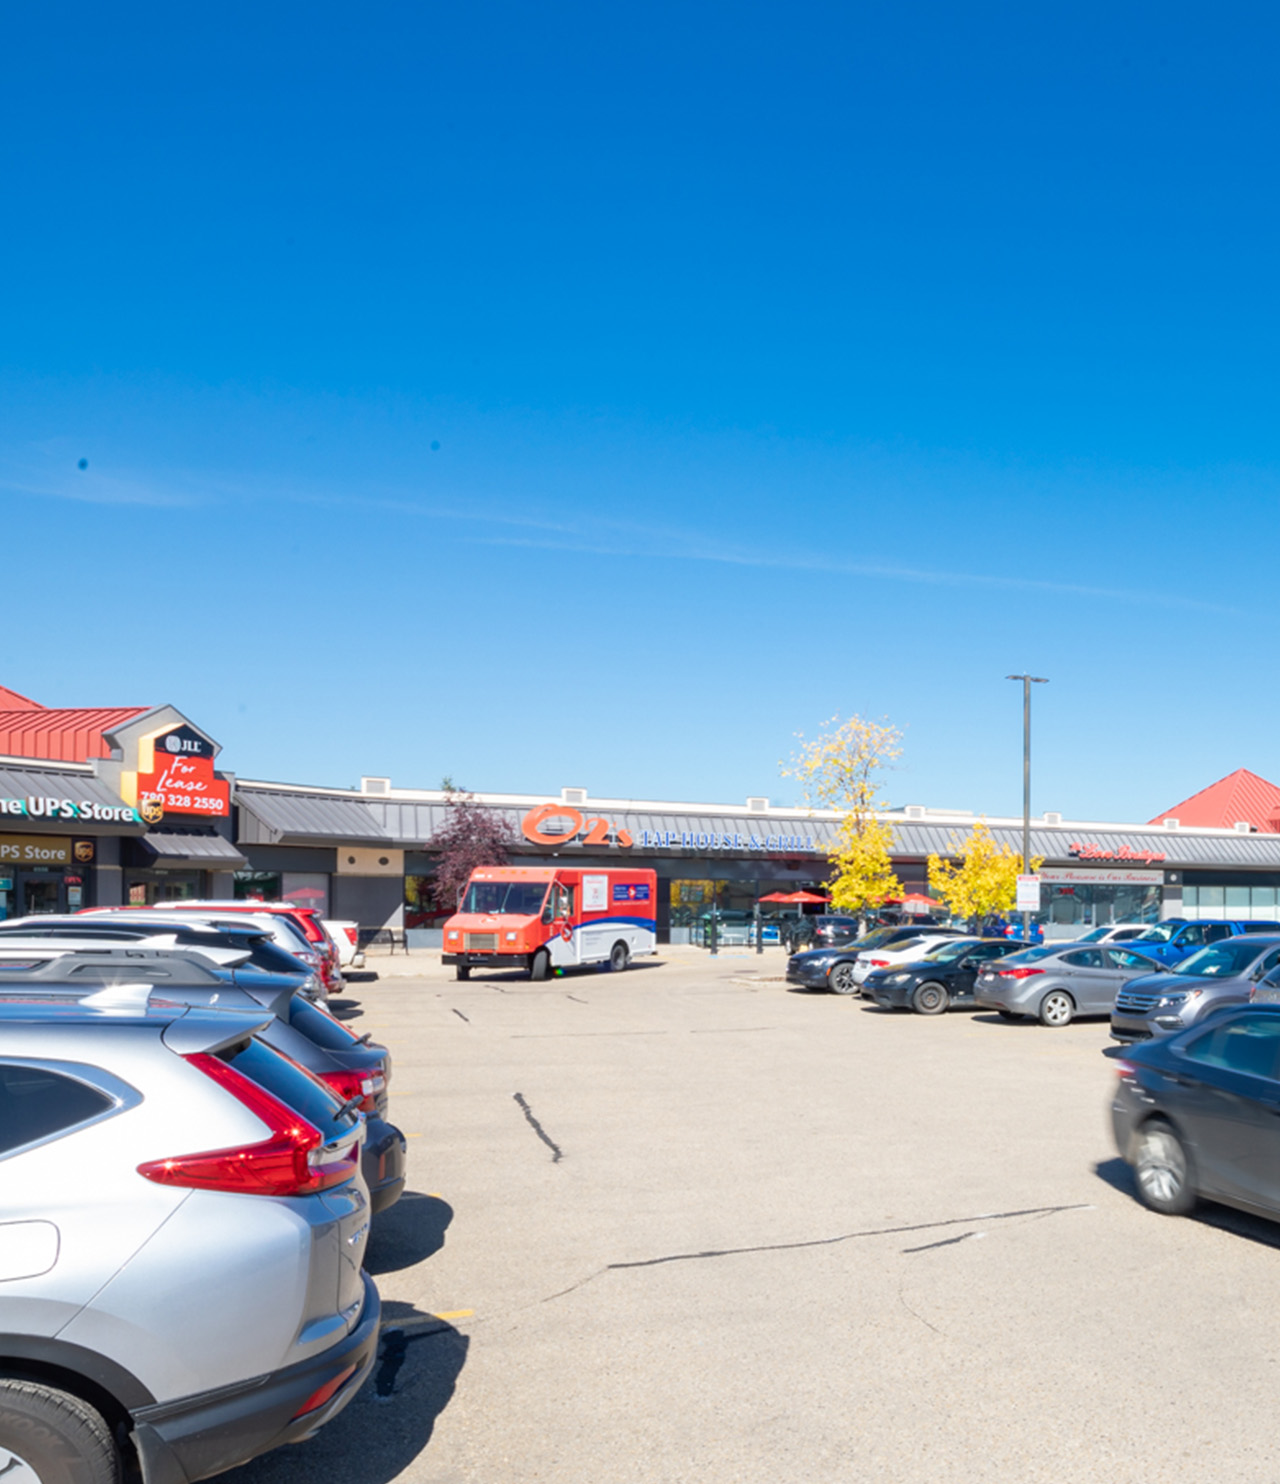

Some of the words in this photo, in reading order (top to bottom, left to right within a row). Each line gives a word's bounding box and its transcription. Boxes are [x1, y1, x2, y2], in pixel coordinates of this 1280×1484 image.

[181, 741, 202, 752] JLL
[171, 755, 196, 774] For
[156, 770, 208, 792] Lease
[28, 796, 73, 818] UPS
[79, 800, 134, 822] Store
[167, 793, 192, 807] 328
[193, 795, 225, 810] 2550
[637, 828, 677, 848] TAP
[680, 831, 745, 850] HOUSE
[749, 834, 762, 851] &
[764, 835, 817, 852] GRILL
[25, 846, 66, 859] Store
